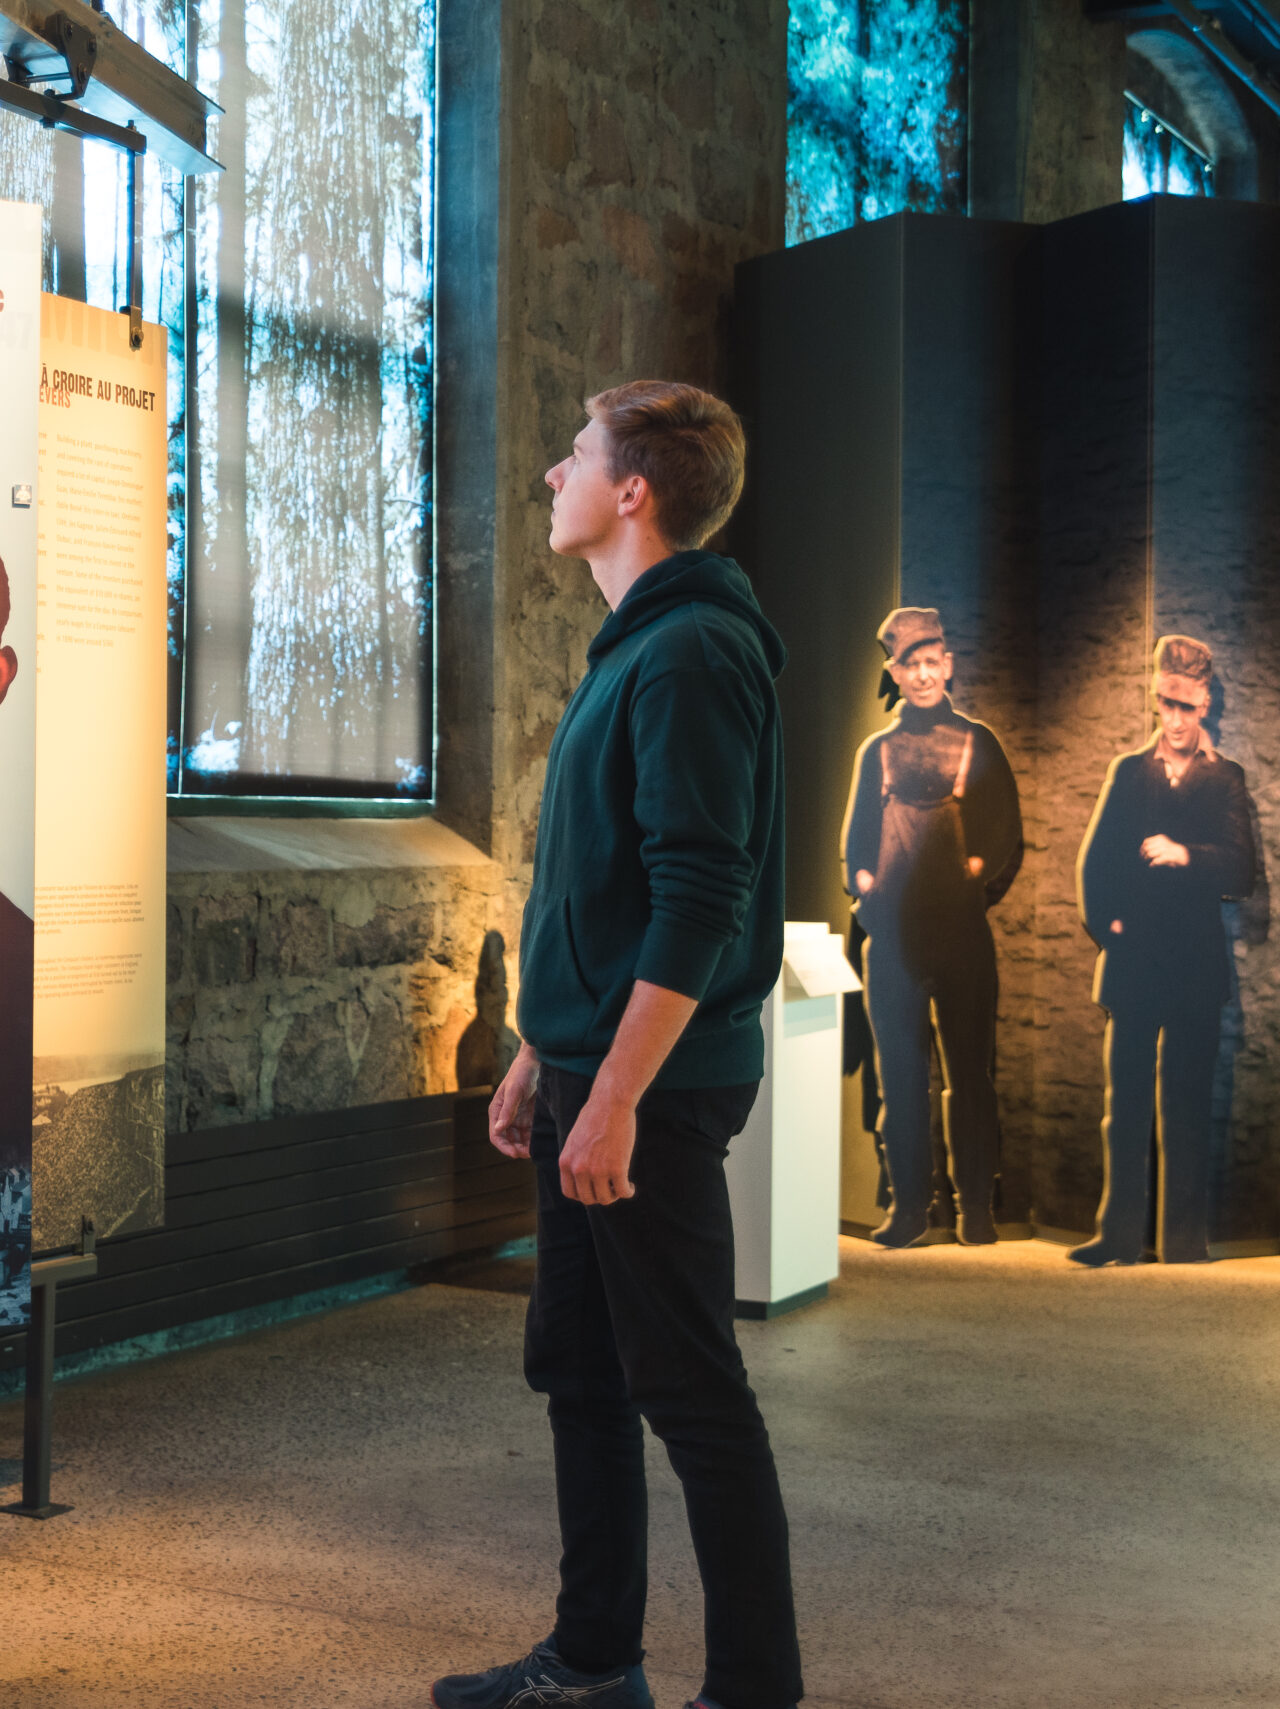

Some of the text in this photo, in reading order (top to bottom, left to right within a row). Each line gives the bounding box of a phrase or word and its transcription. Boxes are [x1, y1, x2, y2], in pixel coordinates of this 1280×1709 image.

[53, 369, 93, 398] CROIRE
[97, 379, 112, 402] AU
[115, 384, 156, 412] PROJET
